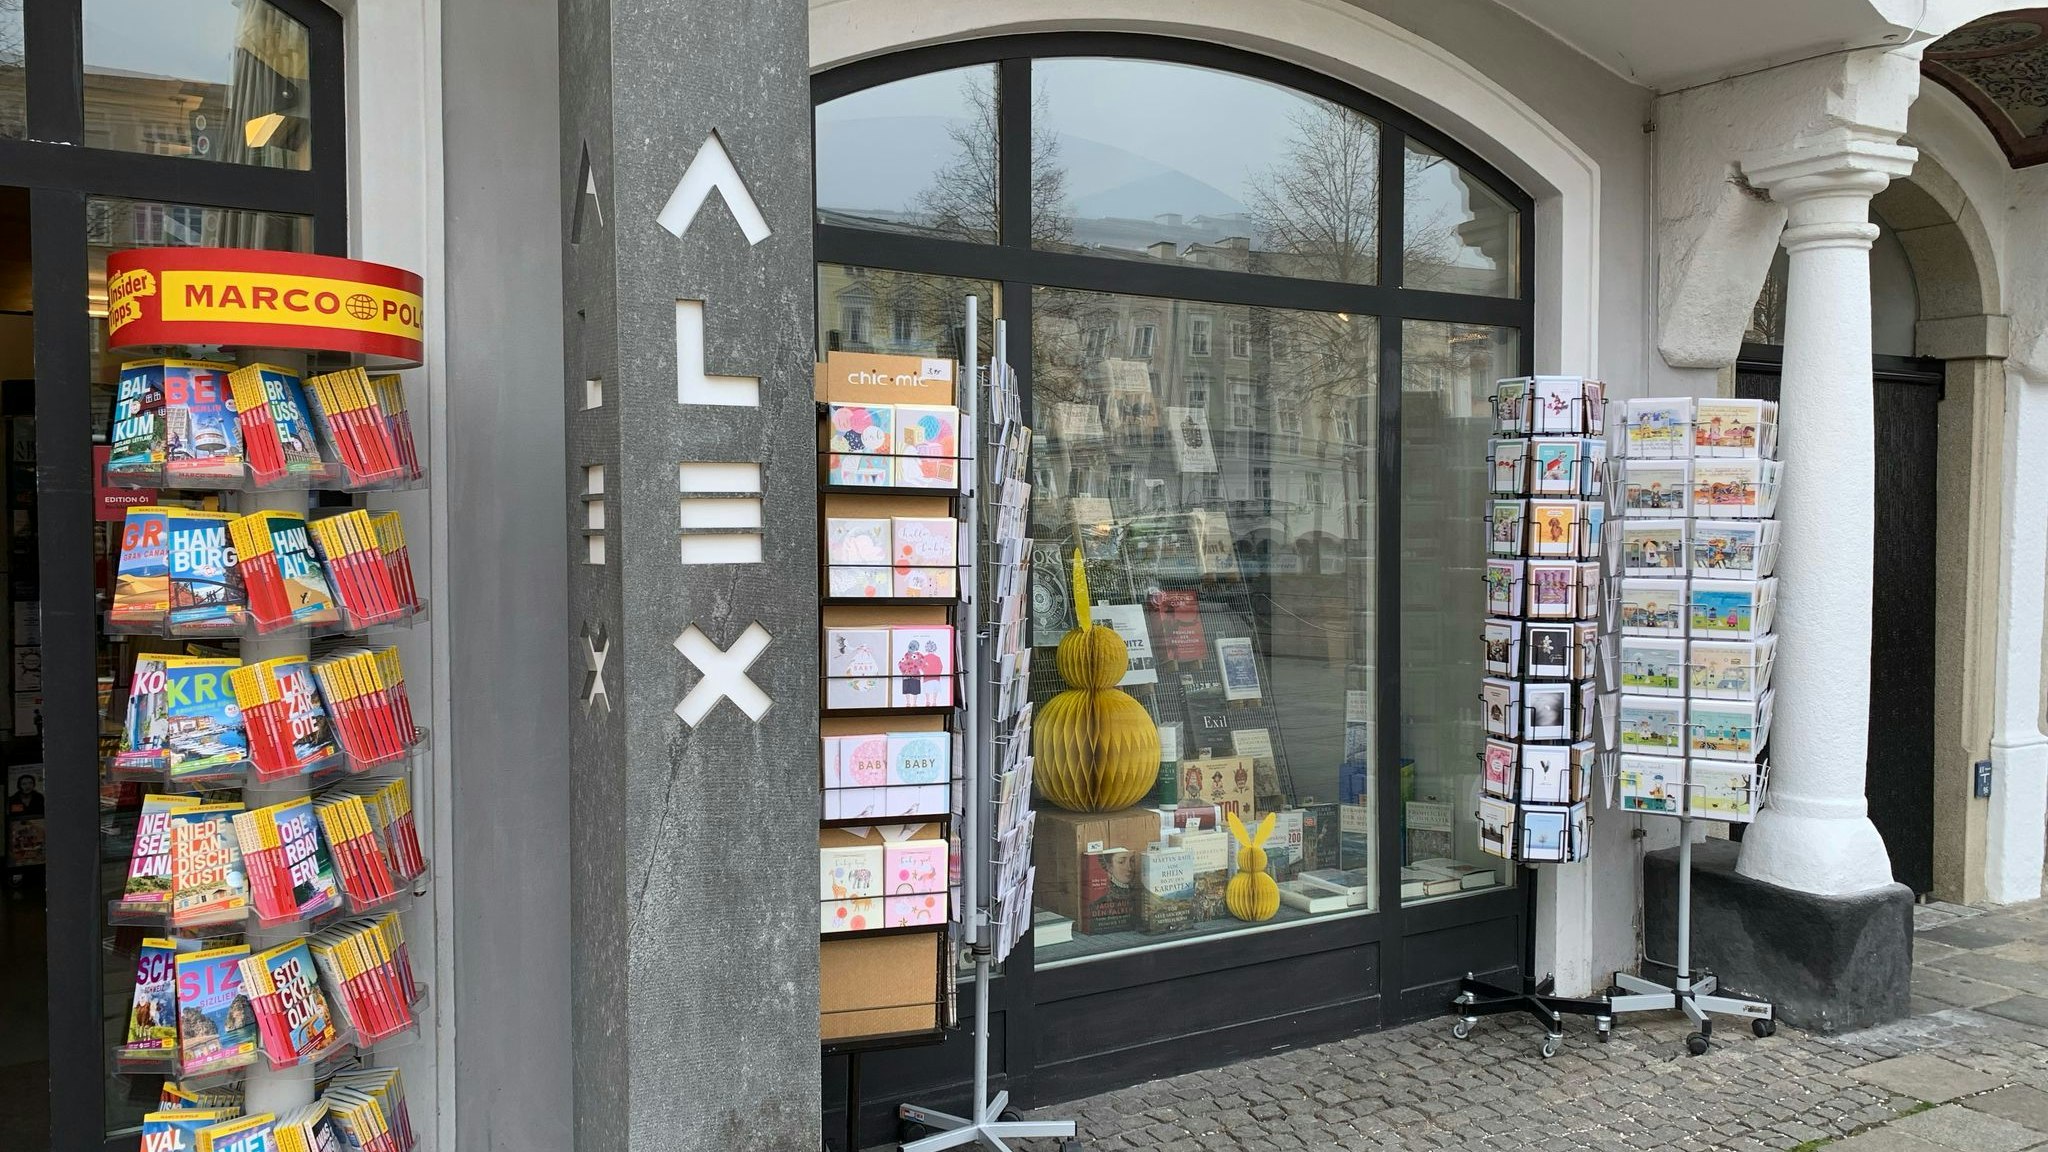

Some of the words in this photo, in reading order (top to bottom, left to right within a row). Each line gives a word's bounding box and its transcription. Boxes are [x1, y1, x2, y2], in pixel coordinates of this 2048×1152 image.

[109, 275, 147, 306] Insider
[185, 284, 341, 314] MARCO
[122, 374, 151, 400] BAL
[265, 380, 286, 401] BR
[271, 400, 299, 422] ÜSS
[115, 413, 154, 442] KUM
[656, 127, 774, 729] ALEX
[174, 527, 226, 552] HAM
[274, 526, 310, 556] HAW
[174, 546, 238, 573] BURG
[280, 669, 309, 697] LAN
[289, 692, 315, 721] ZAR
[292, 717, 320, 740] OTE
[1203, 715, 1228, 730] Exil
[905, 758, 936, 769] BABY
[177, 818, 227, 842] NIEDE
[281, 813, 310, 844] OBE
[137, 833, 171, 856] SEE
[178, 835, 222, 859] RLAN
[285, 828, 319, 868] RBAY
[178, 847, 241, 874] DISCHE
[290, 854, 321, 887] ERN
[179, 959, 242, 1003] SIZ
[274, 957, 302, 989] STO
[200, 990, 237, 1008] SIZILIEN
[281, 974, 311, 1009] CKH
[287, 994, 322, 1030] OLM
[145, 1127, 186, 1152] VAL
